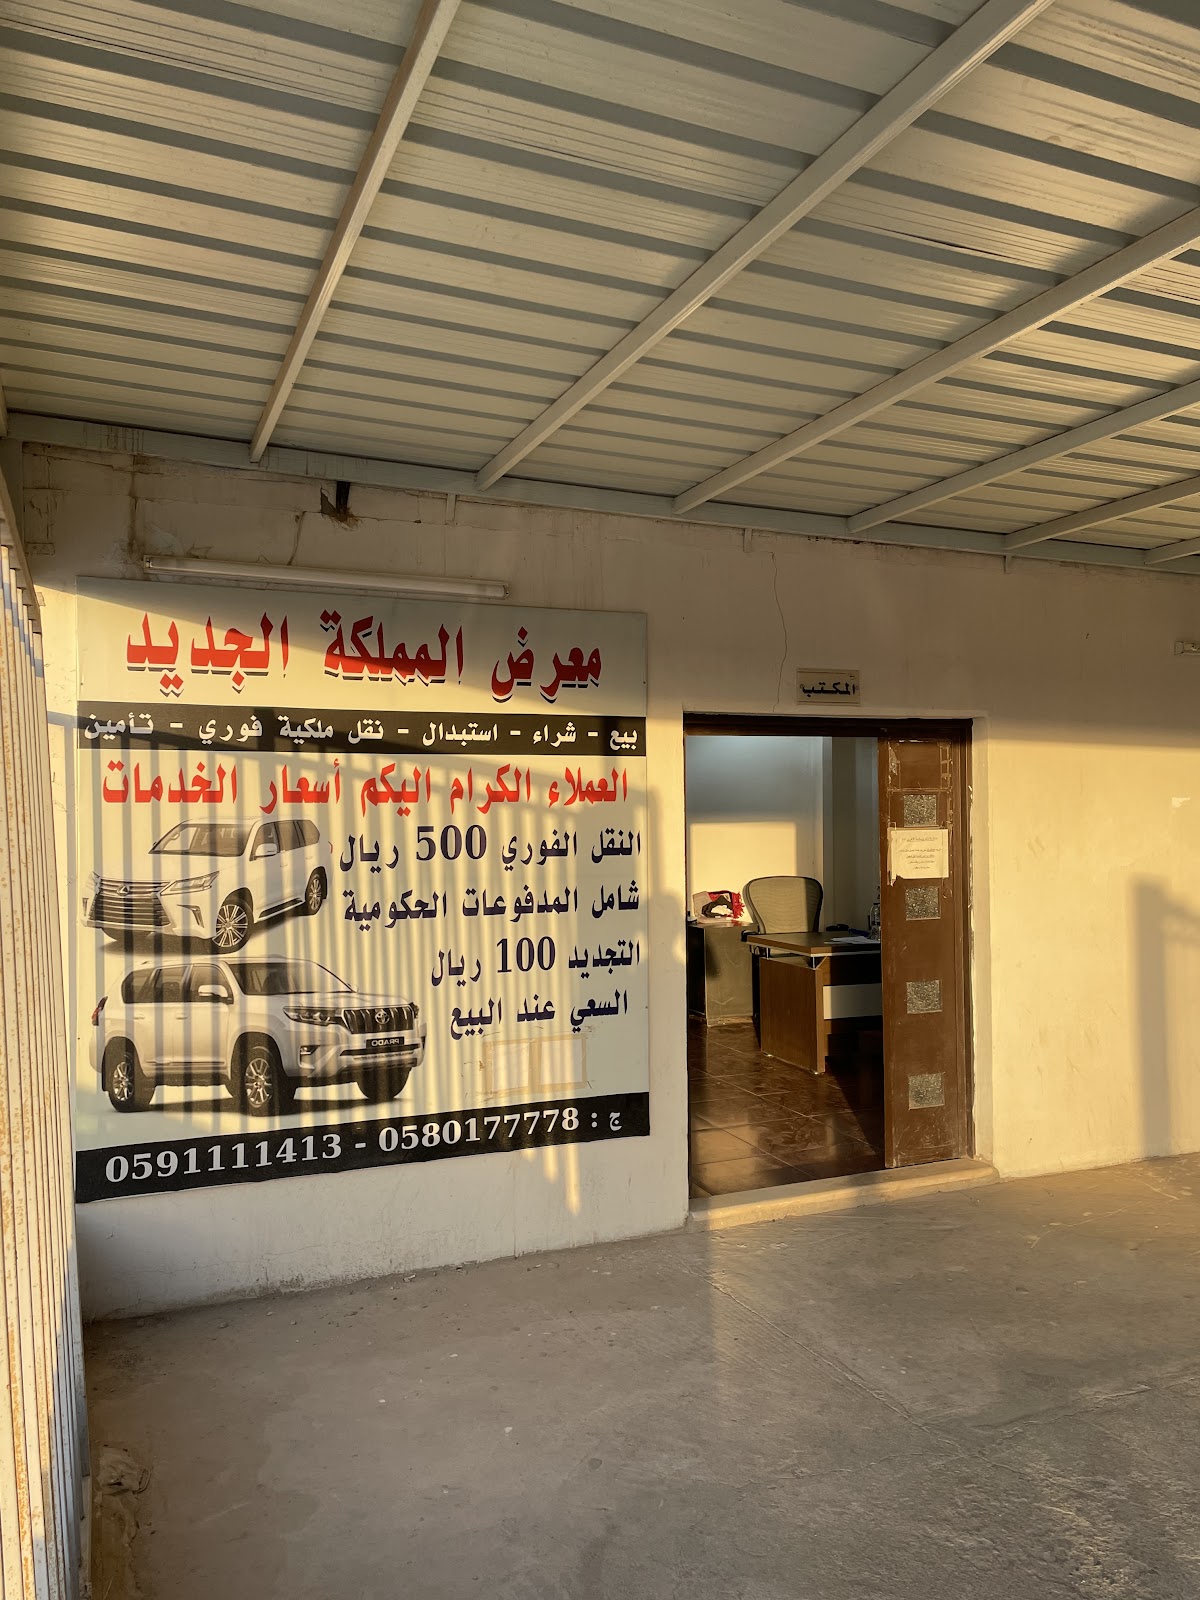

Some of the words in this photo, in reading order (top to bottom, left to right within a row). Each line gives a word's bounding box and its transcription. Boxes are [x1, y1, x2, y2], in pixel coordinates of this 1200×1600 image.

[126, 612, 289, 697] الجديد
[320, 609, 464, 685] المملكة
[491, 627, 601, 703] معرض
[802, 682, 855, 697] المكتب
[84, 712, 154, 740] تأمين
[199, 715, 263, 745] فوري
[278, 715, 334, 745] ملكية
[348, 719, 384, 744] نقل
[422, 721, 498, 746] استبدال
[532, 721, 577, 747] شراء
[609, 728, 638, 750] بيع
[103, 760, 238, 804] الخدمات
[260, 758, 341, 814] أسعار
[361, 763, 431, 817] اليكم
[449, 763, 531, 815] الكرام
[548, 766, 628, 808] العملاء
[339, 834, 400, 874] ريال
[415, 824, 488, 861] 500
[501, 829, 578, 871] الفوري
[591, 827, 641, 863] النقل
[343, 889, 447, 932] الحكومية
[462, 885, 578, 922] المدفوعات
[591, 880, 640, 918] شامل
[431, 949, 482, 987] ريال
[496, 936, 556, 974] 100
[568, 939, 641, 979] التجديد
[450, 997, 502, 1041] البيع
[516, 994, 556, 1023] عند
[570, 989, 628, 1034] السعي
[378, 1107, 580, 1152] 0580177778
[105, 1133, 342, 1183] 0591111413
